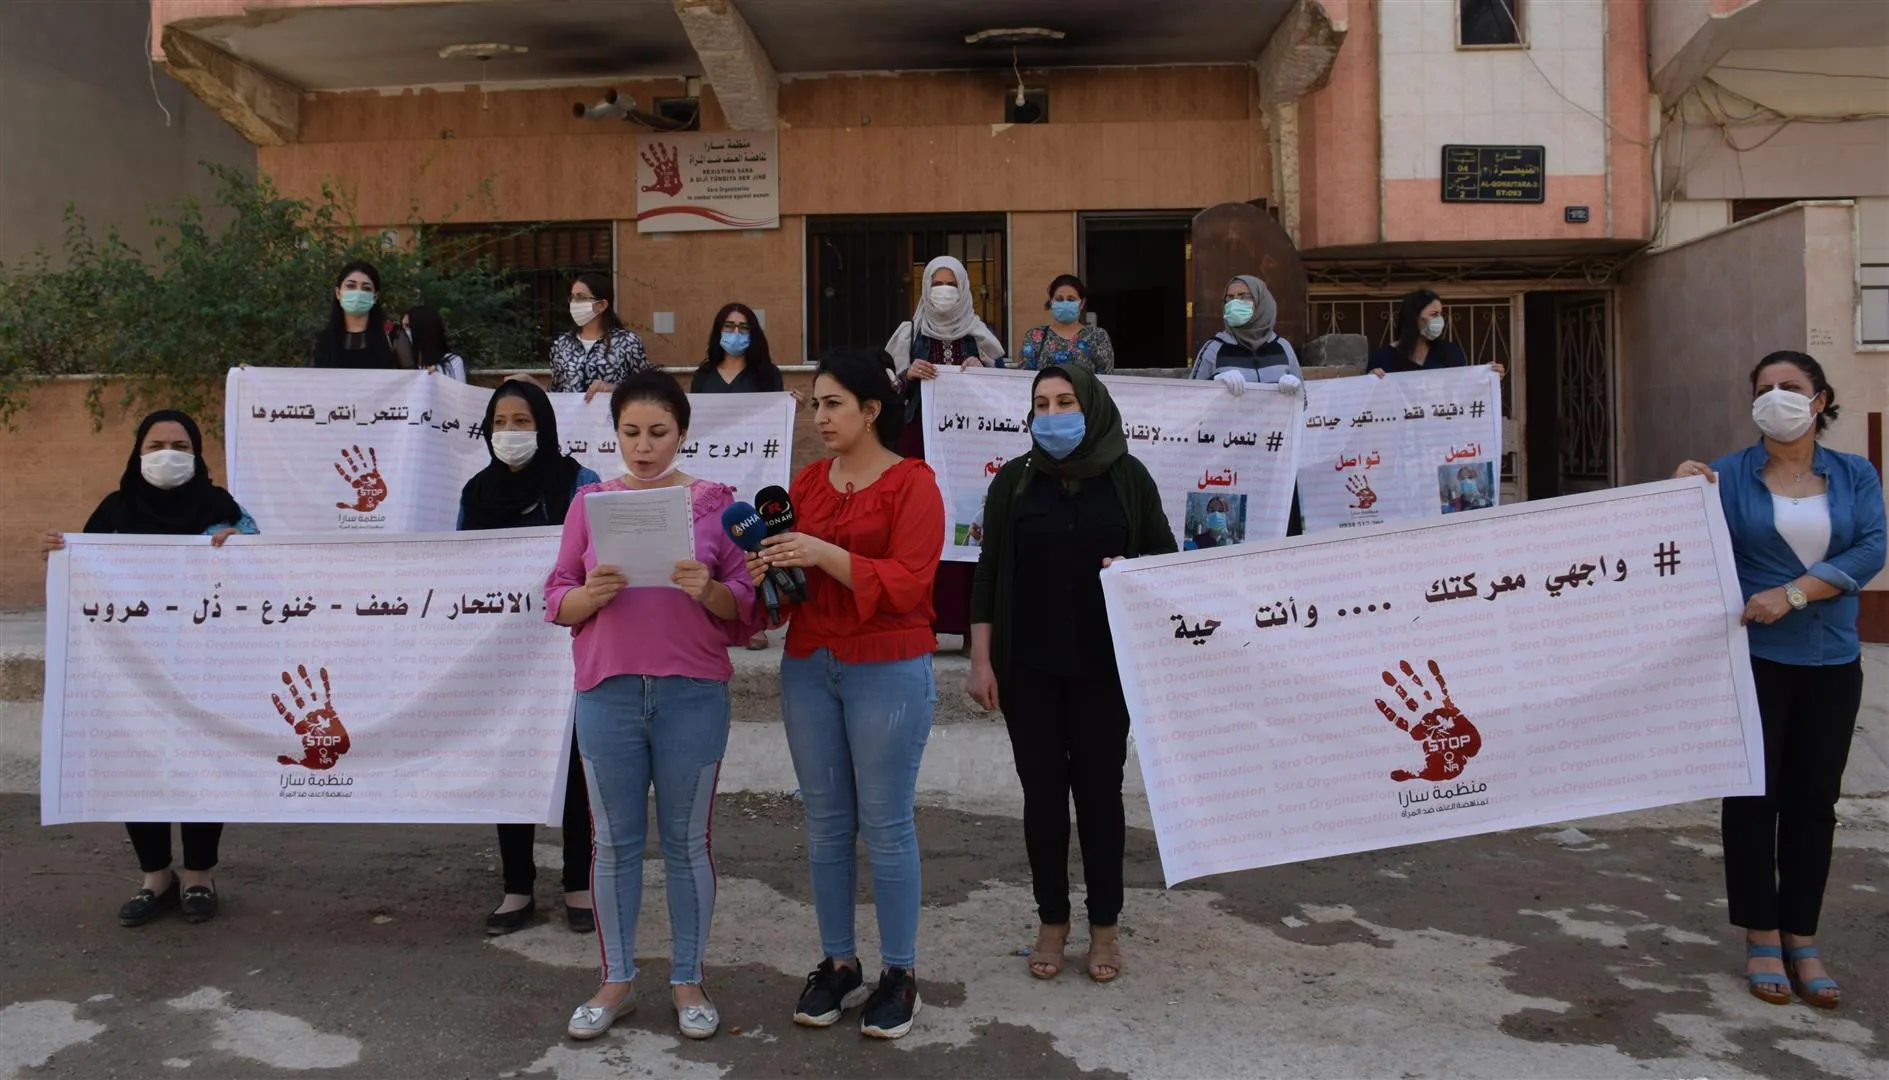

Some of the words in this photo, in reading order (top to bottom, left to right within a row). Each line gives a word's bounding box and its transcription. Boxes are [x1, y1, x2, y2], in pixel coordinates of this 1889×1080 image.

[1403, 406, 1425, 420] فقط
[1432, 403, 1464, 420] دقيقة
[1470, 400, 1485, 418] #
[938, 413, 969, 432] الأمل
[1306, 413, 1341, 430] حياتك
[762, 439, 780, 459] #
[1223, 431, 1257, 448] لنعمل
[1266, 431, 1284, 452] #
[709, 441, 754, 458] الروح
[1445, 443, 1481, 463] اتصل
[1334, 450, 1382, 473] تواصل
[1197, 468, 1238, 490] اتصل
[359, 488, 383, 497] STOP
[734, 514, 761, 534] ANHA
[1653, 540, 1681, 577] #
[1545, 554, 1628, 598] واجهي
[83, 599, 150, 623] هروب
[261, 595, 316, 625] خنوع
[355, 594, 409, 617] ضعف
[446, 591, 531, 620] الانتحار
[1170, 614, 1222, 647] حية
[306, 735, 342, 747] STOP
[1428, 734, 1471, 752] STOP
[279, 773, 306, 789] سارا
[307, 773, 354, 787] منظمة
[1398, 789, 1430, 808] سارا
[1432, 780, 1487, 800] منظمة
[1423, 806, 1435, 815] ضد
[1436, 803, 1457, 813] العنف
[1457, 798, 1489, 809] لمناهضة
